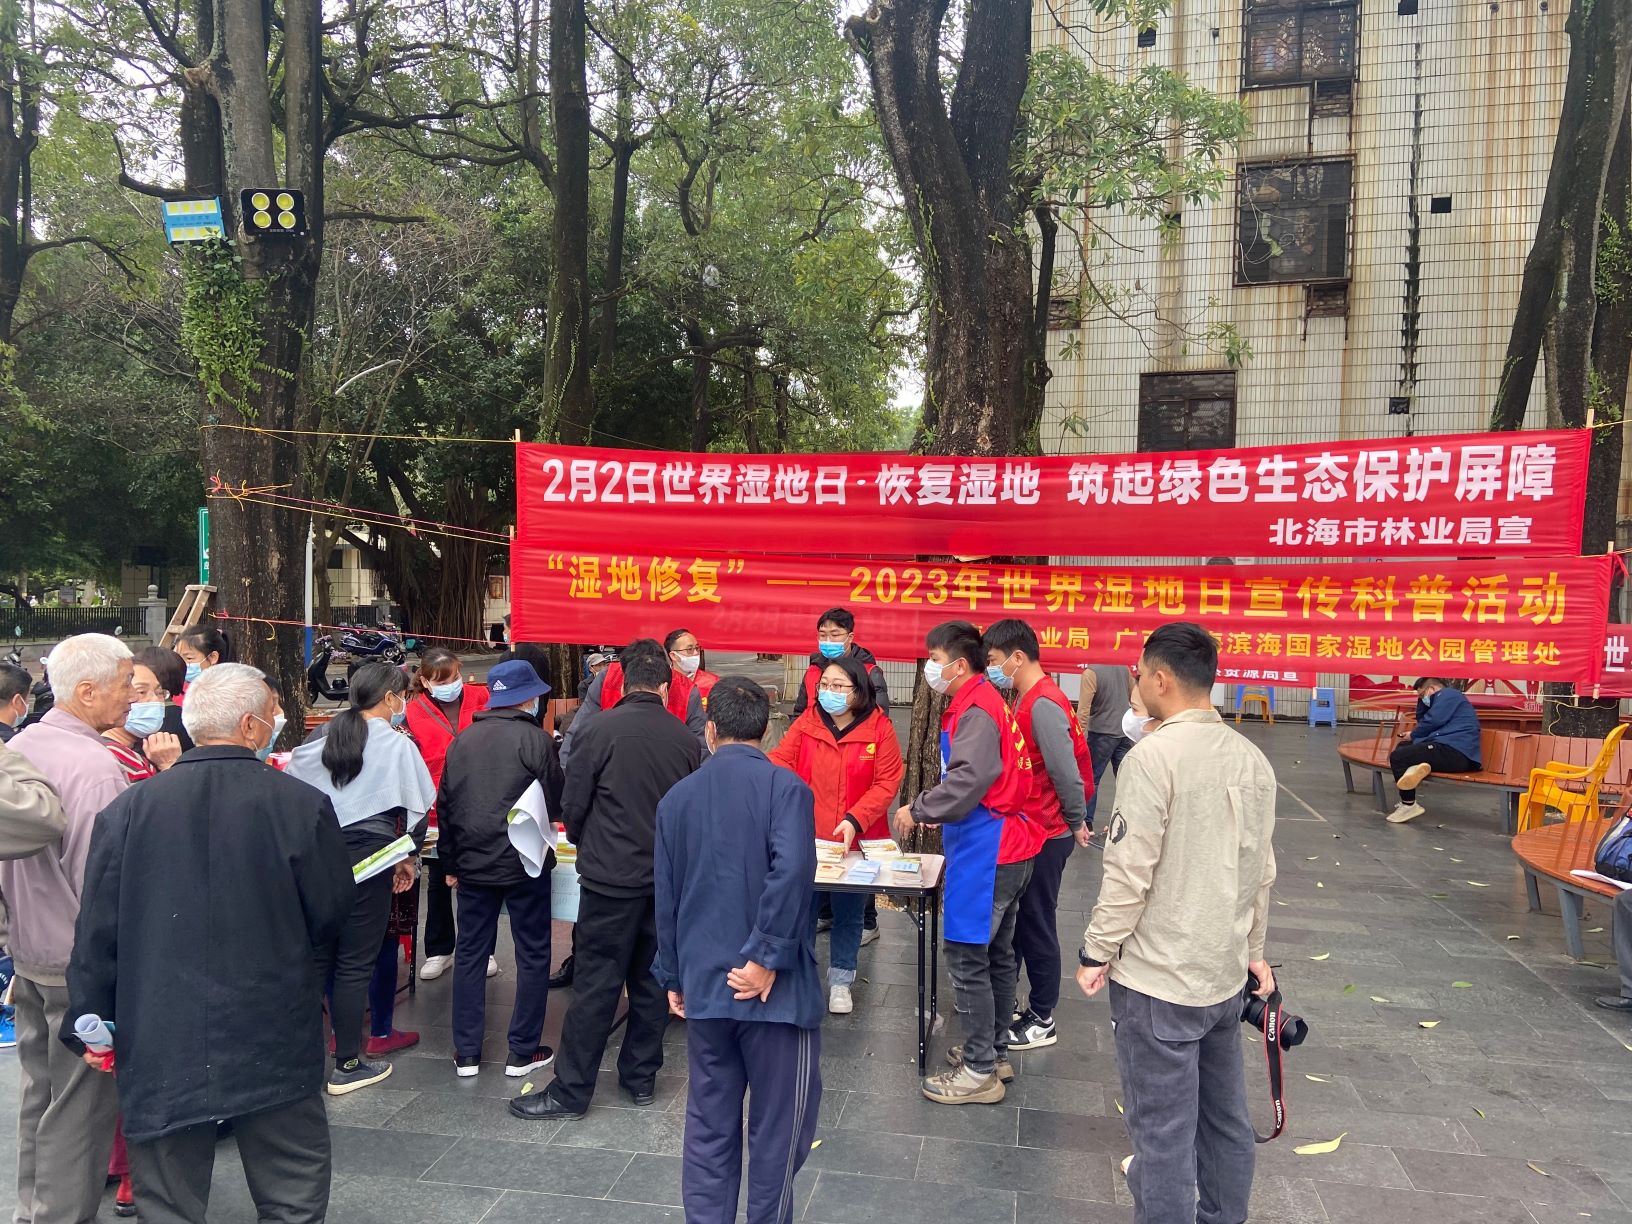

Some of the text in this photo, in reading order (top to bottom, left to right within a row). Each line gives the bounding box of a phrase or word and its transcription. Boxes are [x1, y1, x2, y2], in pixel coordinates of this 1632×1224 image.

[1066, 442, 1557, 506] 筑起绿色生态保护屏障
[1268, 515, 1533, 547] 北海市林业局宣
[1113, 627, 1561, 666] 广滨海国家湿地公园管理处
[1603, 635, 1632, 673] 世
[1268, 1011, 1276, 1042] Canon
